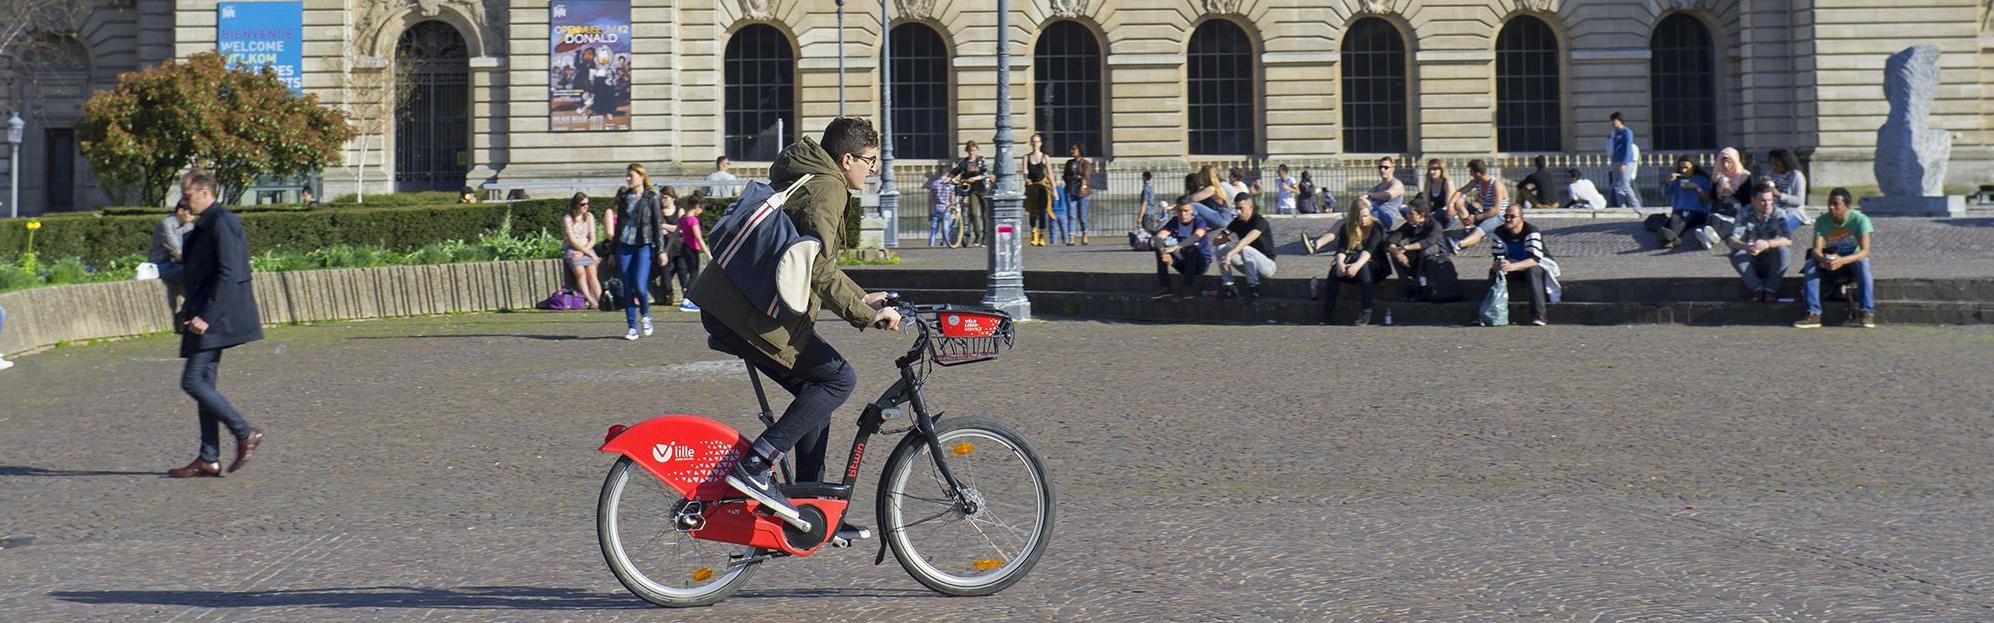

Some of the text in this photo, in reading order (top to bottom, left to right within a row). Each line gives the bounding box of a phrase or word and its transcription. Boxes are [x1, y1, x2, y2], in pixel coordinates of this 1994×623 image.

[222, 29, 294, 39] BIENVENUE
[565, 33, 618, 44] DONALD
[220, 40, 285, 52] WELCOME
[675, 445, 695, 458] lille
